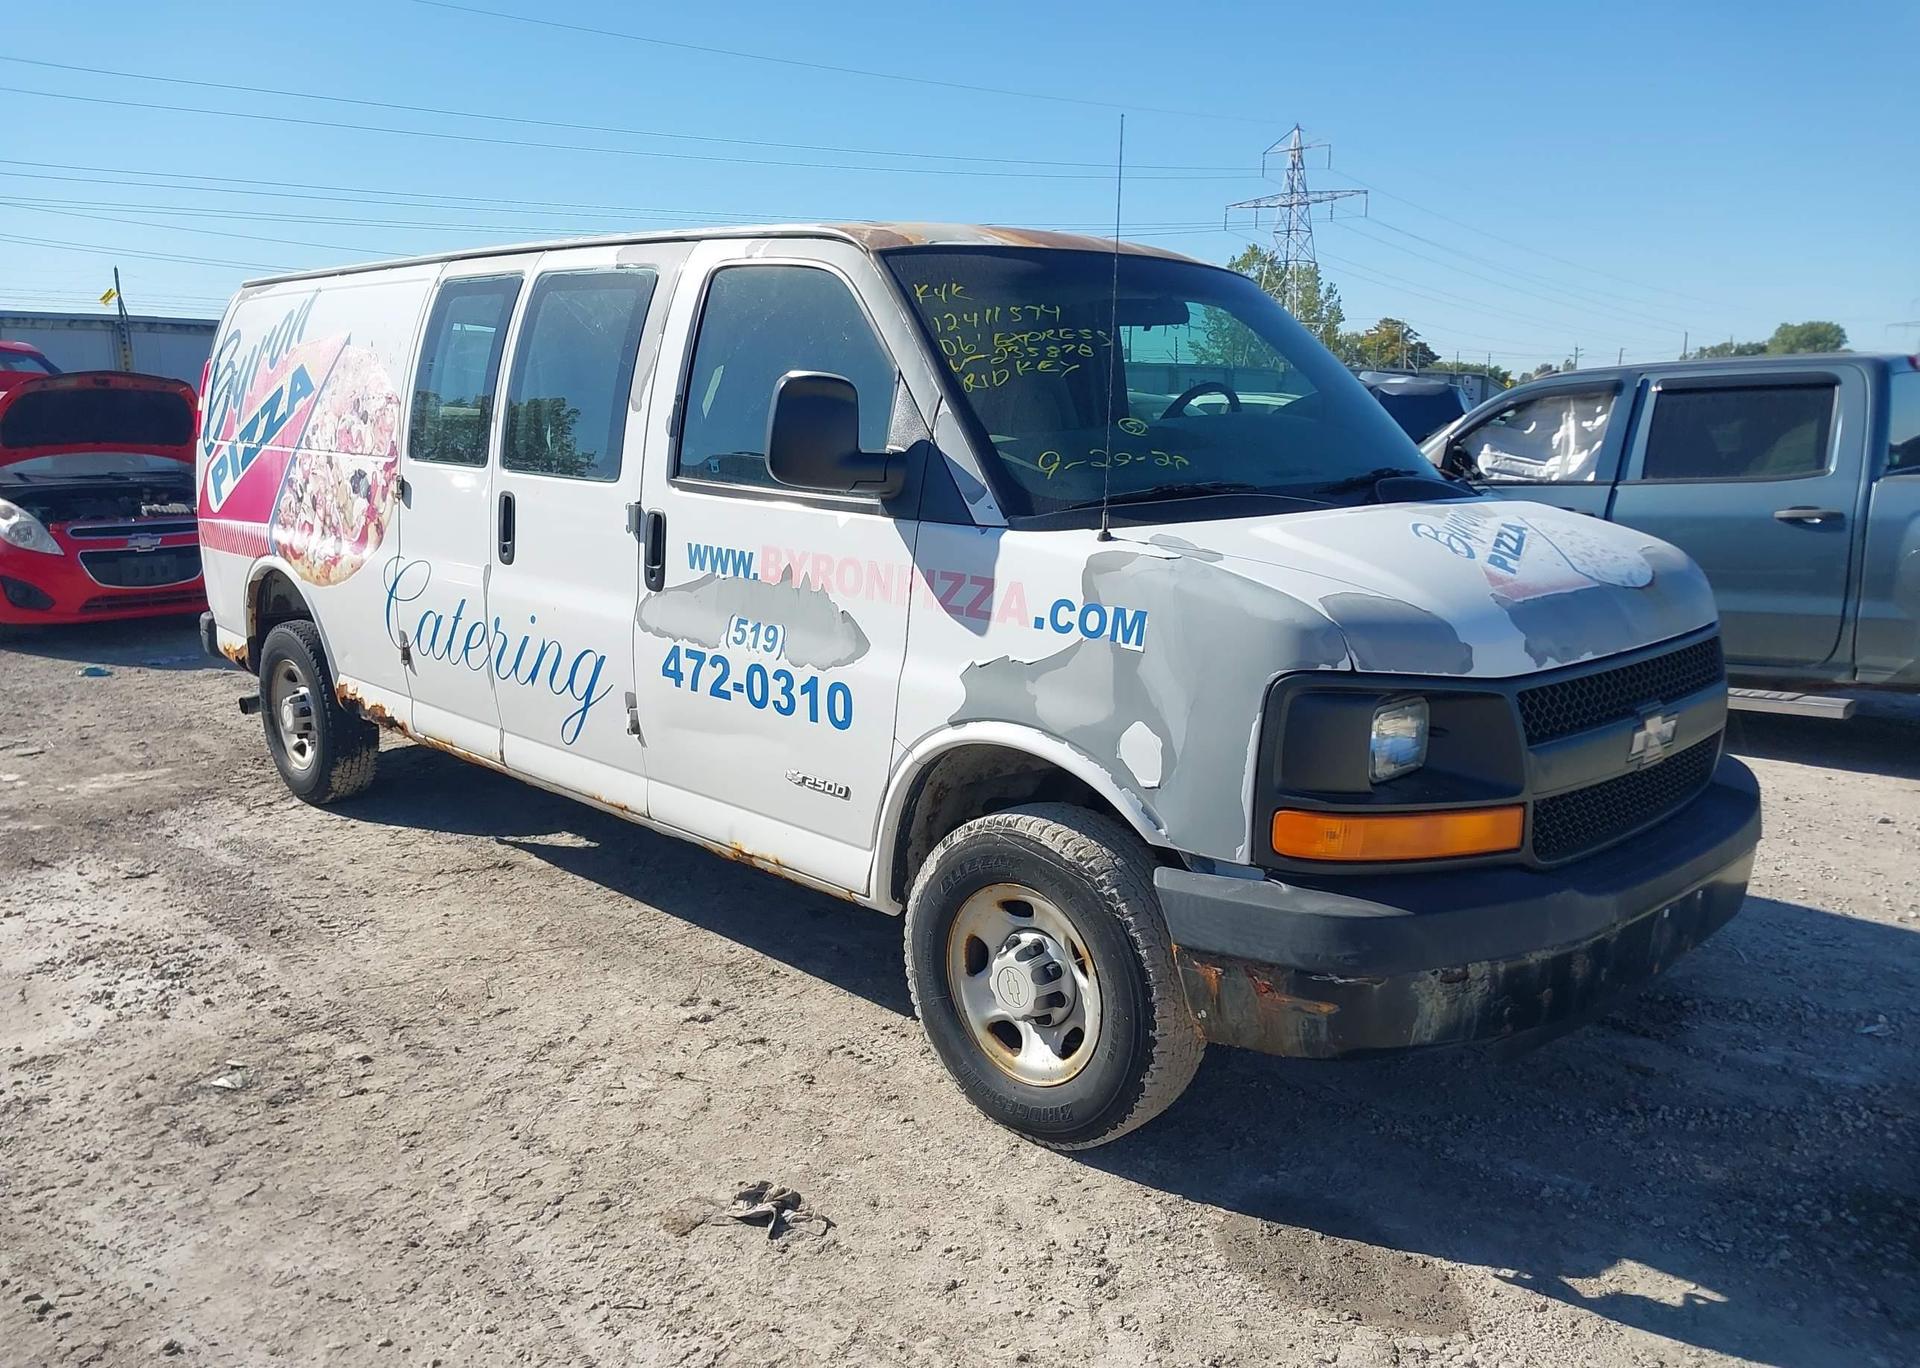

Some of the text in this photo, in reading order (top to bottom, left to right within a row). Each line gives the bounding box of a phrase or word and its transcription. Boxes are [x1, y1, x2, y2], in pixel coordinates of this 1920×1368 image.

[1015, 360, 1081, 378] KEY
[211, 363, 316, 504] PIZZA
[1487, 522, 1528, 575] PIZZA
[383, 556, 614, 745] Catering
[725, 612, 786, 660] (519)
[661, 645, 853, 731] 472-0310
[804, 776, 846, 797] 2500
